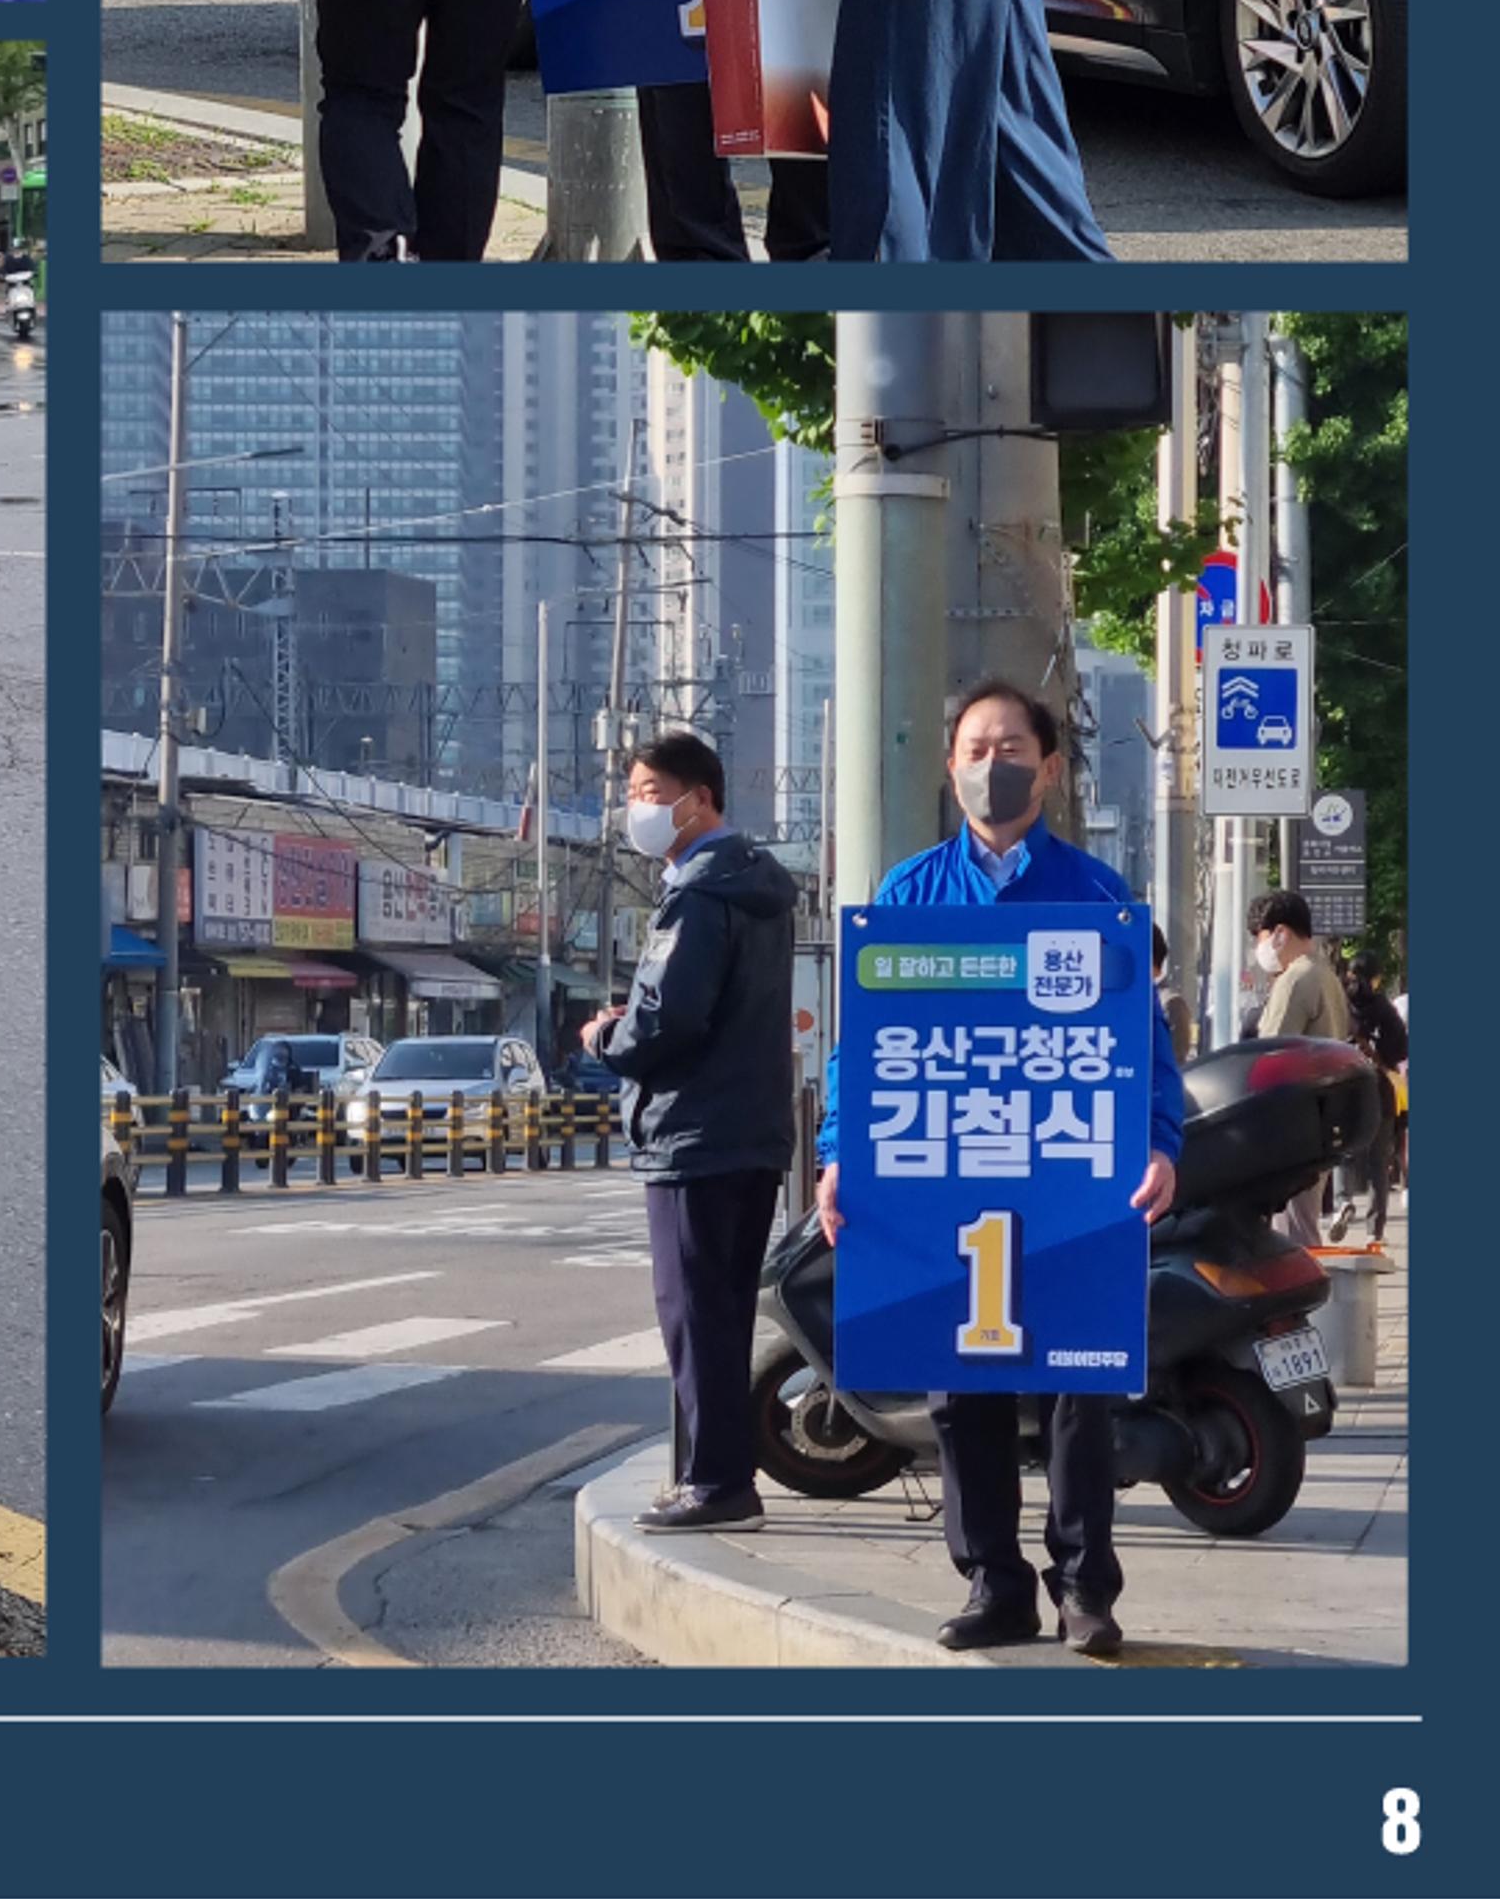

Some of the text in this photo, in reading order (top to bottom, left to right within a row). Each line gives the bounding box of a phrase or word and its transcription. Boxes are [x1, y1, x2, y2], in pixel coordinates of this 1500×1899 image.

[1221, 637, 1294, 662] 청파로
[874, 956, 1018, 978] 일 잘하고 든든한
[1044, 950, 1084, 973] 용산
[1034, 976, 1093, 998] 전문가
[872, 1024, 1118, 1082] 용산구청장
[869, 1087, 1115, 1178] 김철식
[957, 1210, 1023, 1354] 1
[1047, 1350, 1129, 1367] 더불어민주당
